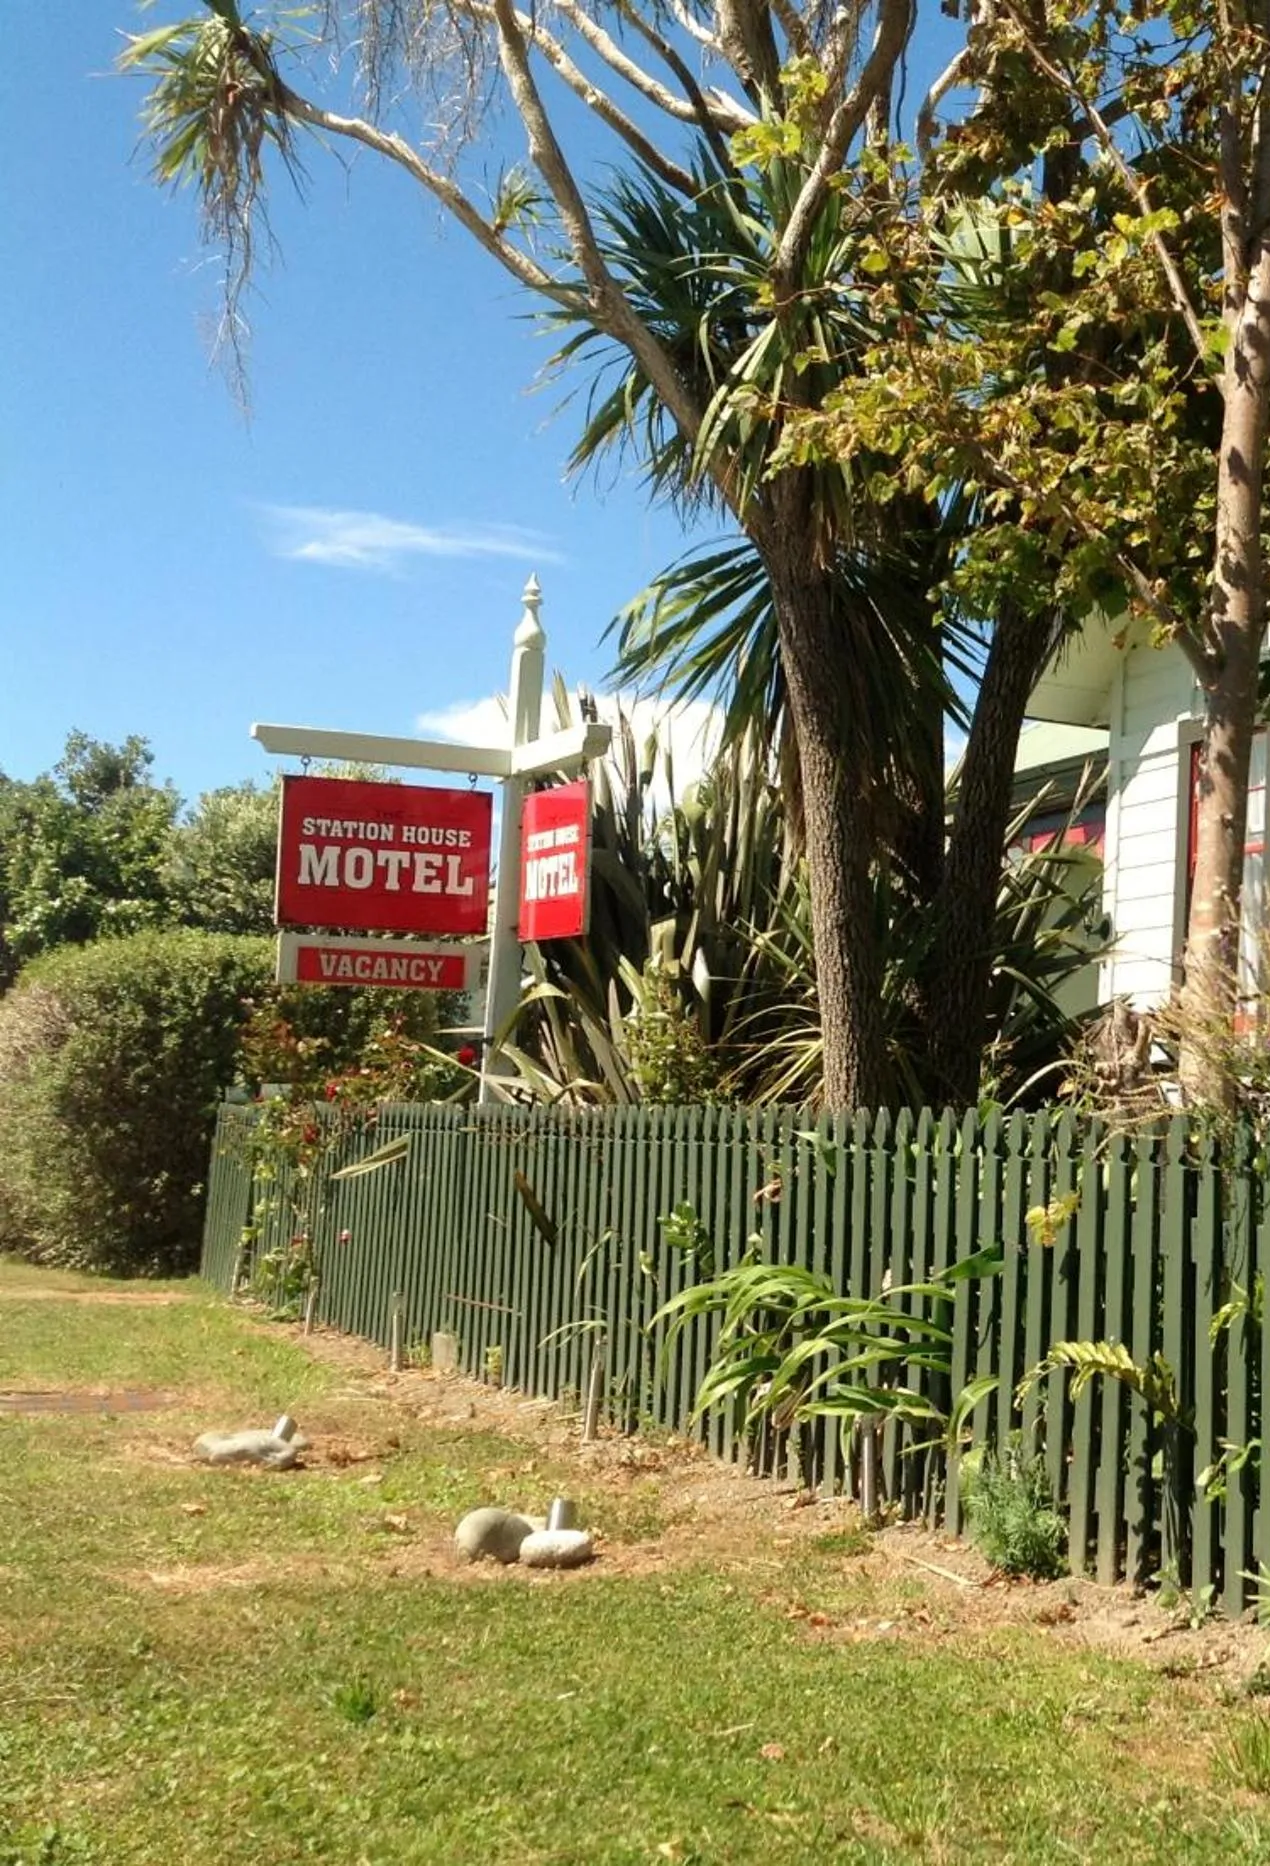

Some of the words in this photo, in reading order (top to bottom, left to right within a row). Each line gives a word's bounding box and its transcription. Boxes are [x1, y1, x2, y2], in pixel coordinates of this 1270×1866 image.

[302, 817, 395, 842] STATION
[402, 825, 472, 848] HOUSE
[297, 844, 475, 896] MOTEL
[320, 954, 445, 982] VACANCY
